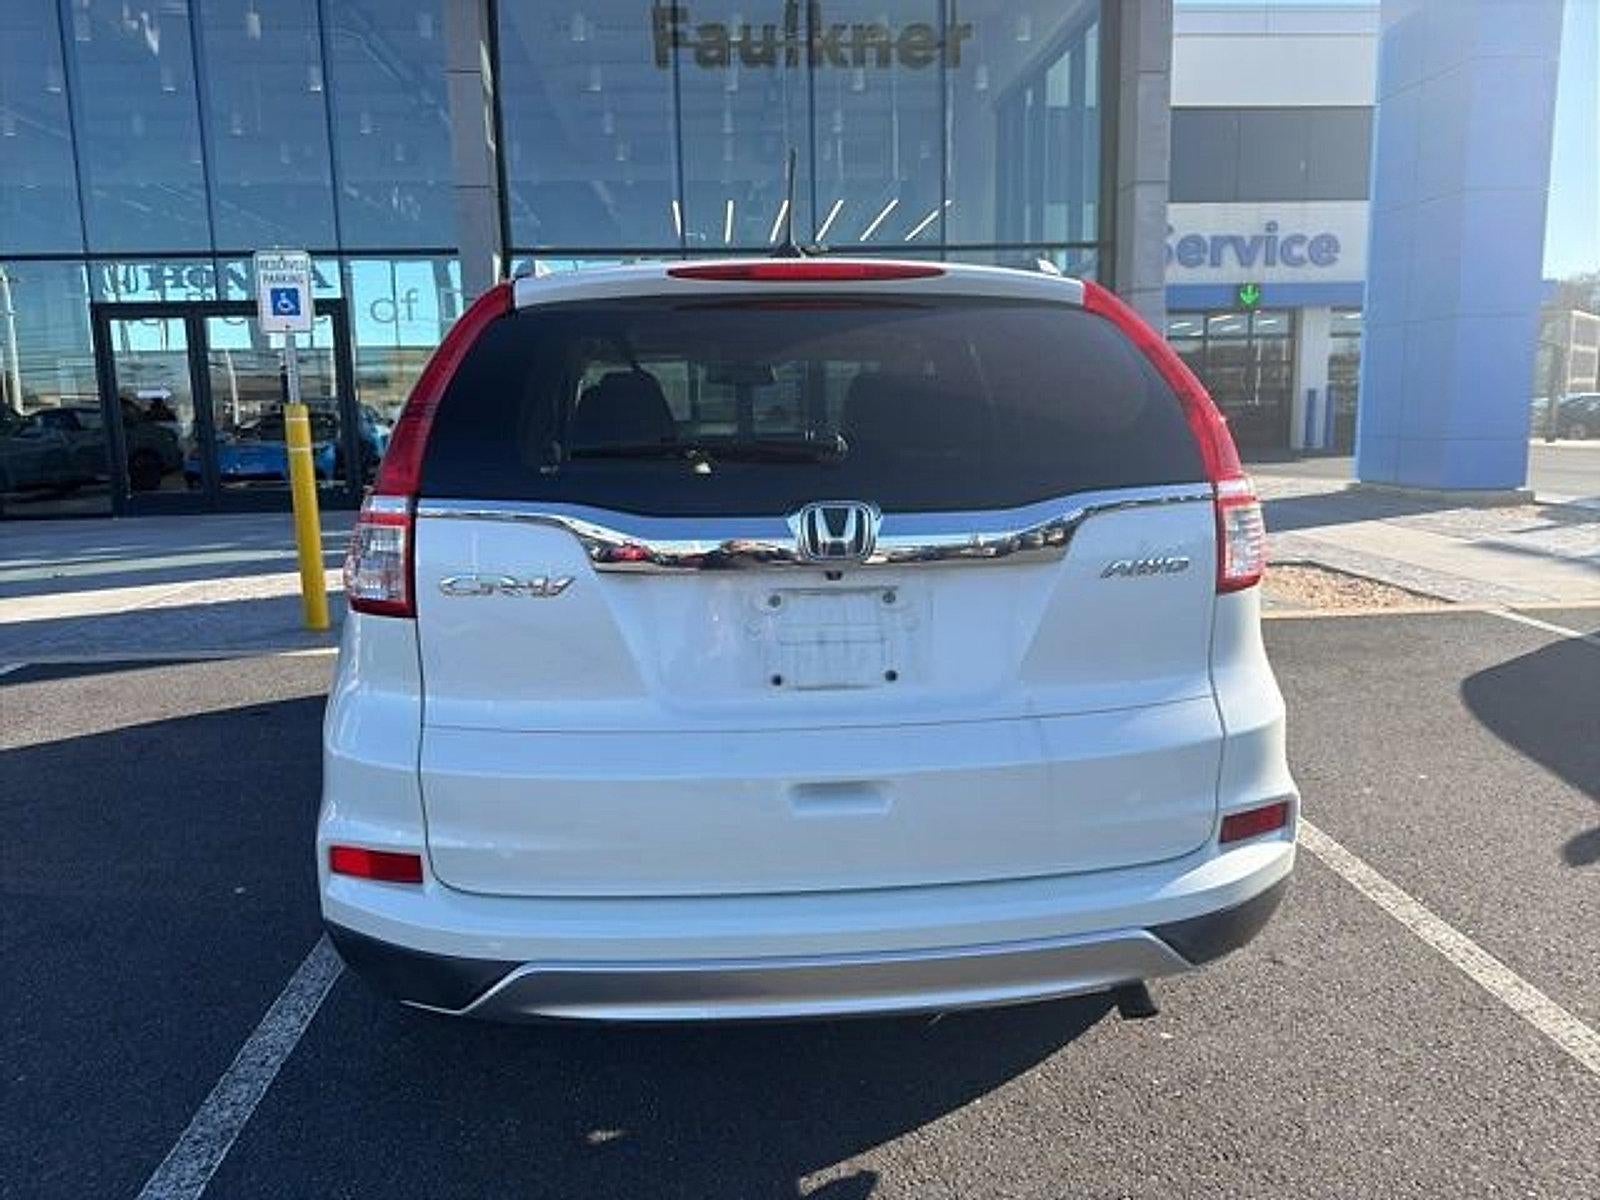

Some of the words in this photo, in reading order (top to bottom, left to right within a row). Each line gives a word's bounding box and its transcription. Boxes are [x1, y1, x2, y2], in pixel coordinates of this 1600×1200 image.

[652, 0, 973, 70] Faulkner
[262, 272, 305, 285] PARKING
[1100, 557, 1190, 579] AWD
